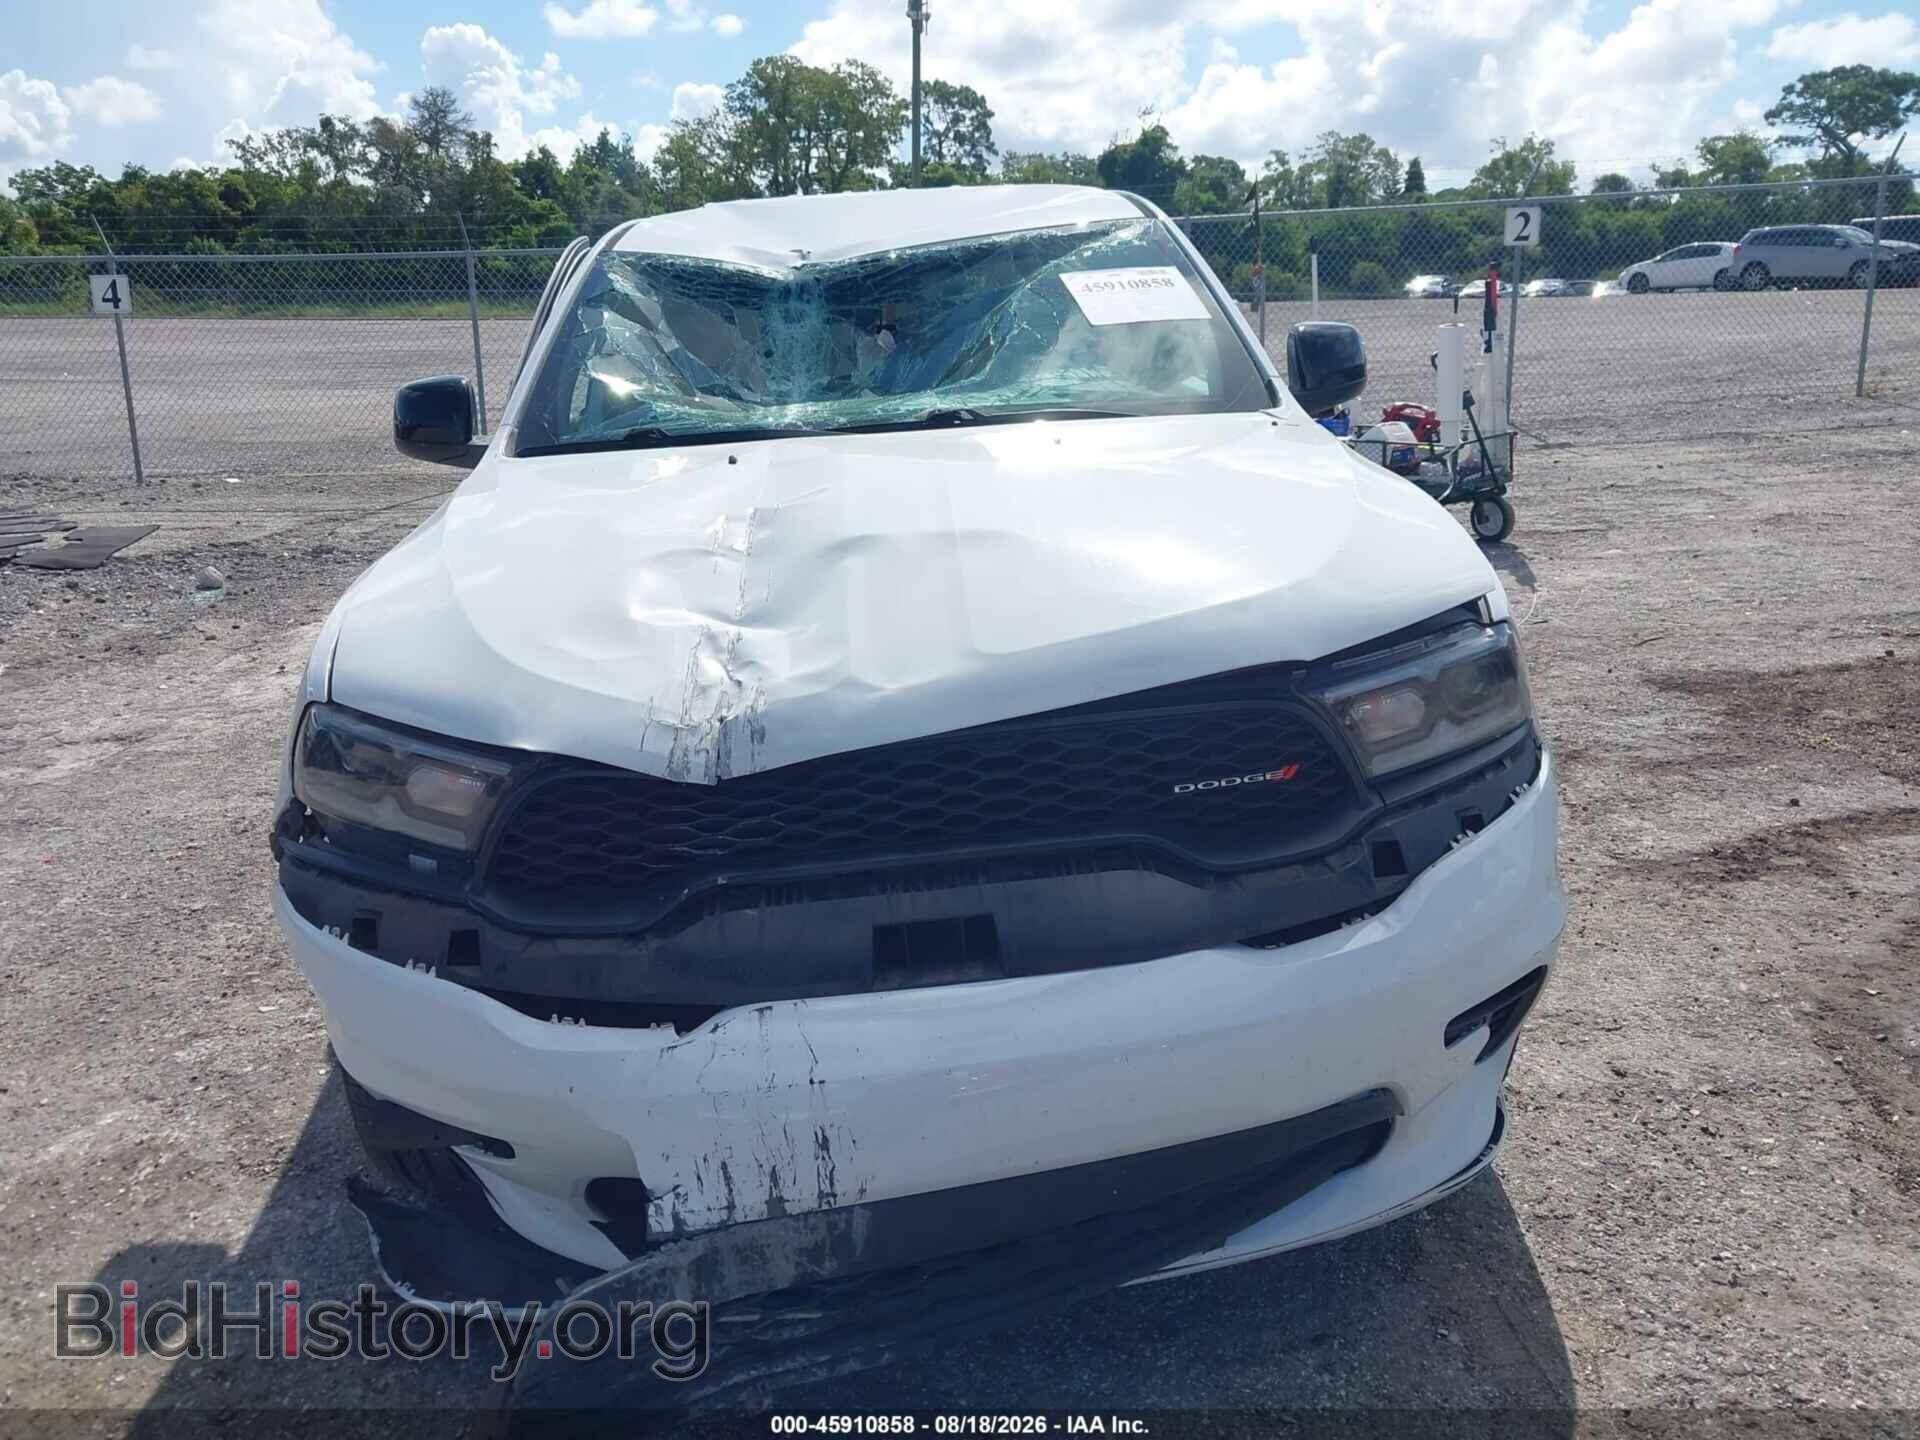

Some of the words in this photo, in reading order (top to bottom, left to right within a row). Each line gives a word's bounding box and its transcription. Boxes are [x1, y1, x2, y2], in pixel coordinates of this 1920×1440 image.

[1513, 211, 1531, 242] 2
[102, 279, 122, 309] 4
[1081, 277, 1176, 294] 45910858
[1173, 768, 1286, 794] DODGE
